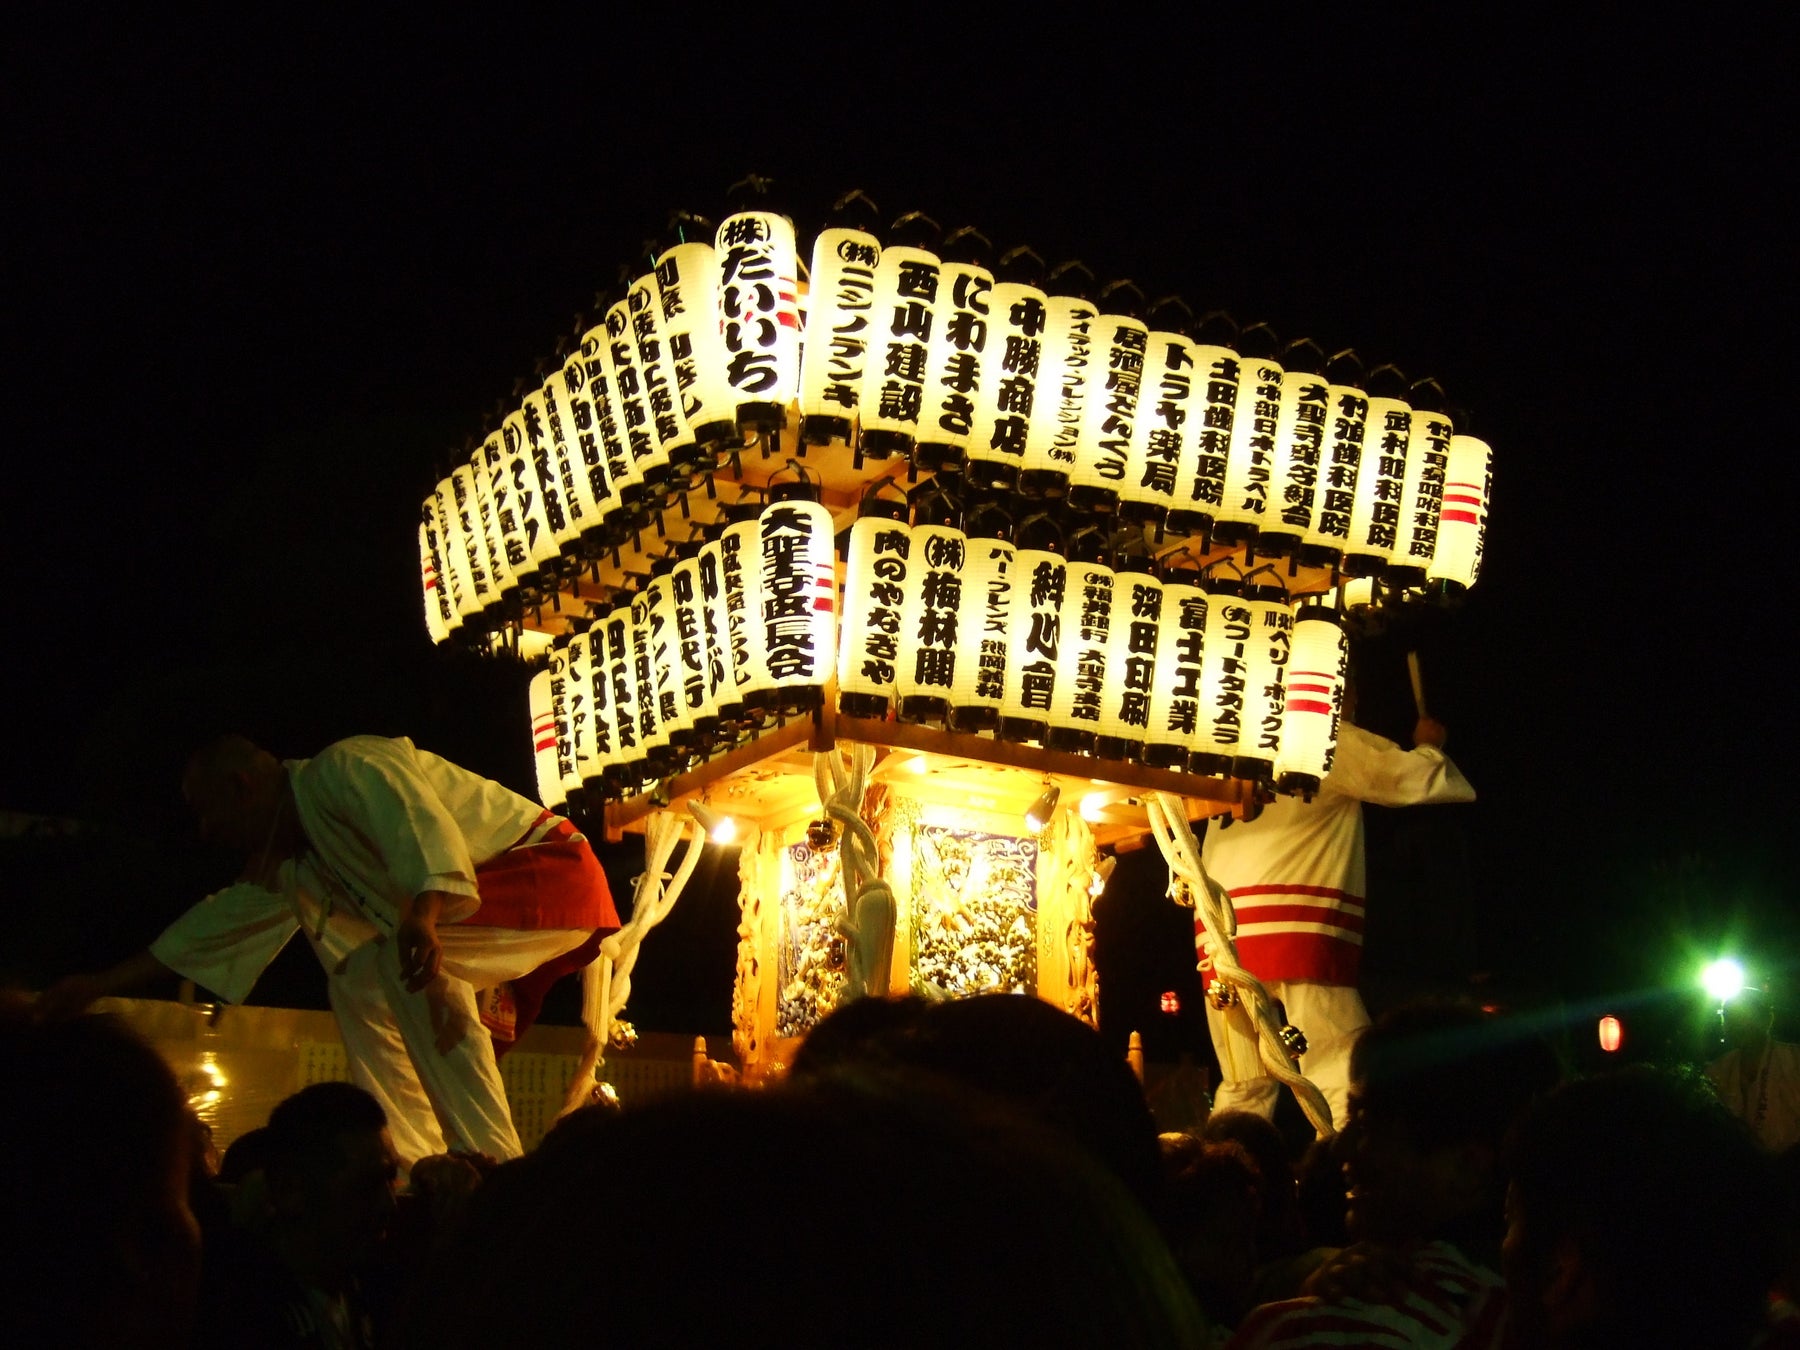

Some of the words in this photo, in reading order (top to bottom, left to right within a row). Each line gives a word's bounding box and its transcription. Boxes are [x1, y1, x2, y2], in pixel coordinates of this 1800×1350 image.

[719, 217, 778, 393] (株)だいいち
[878, 260, 940, 424] 西山建設
[938, 272, 992, 436] にわまさ
[1140, 342, 1194, 497] トラヤ薬局
[760, 507, 815, 680] 大聖寺区長会
[861, 529, 910, 686] 肉のやなぎや
[1118, 583, 1163, 730] 深田印刷
[1167, 595, 1208, 735] 富士工業
